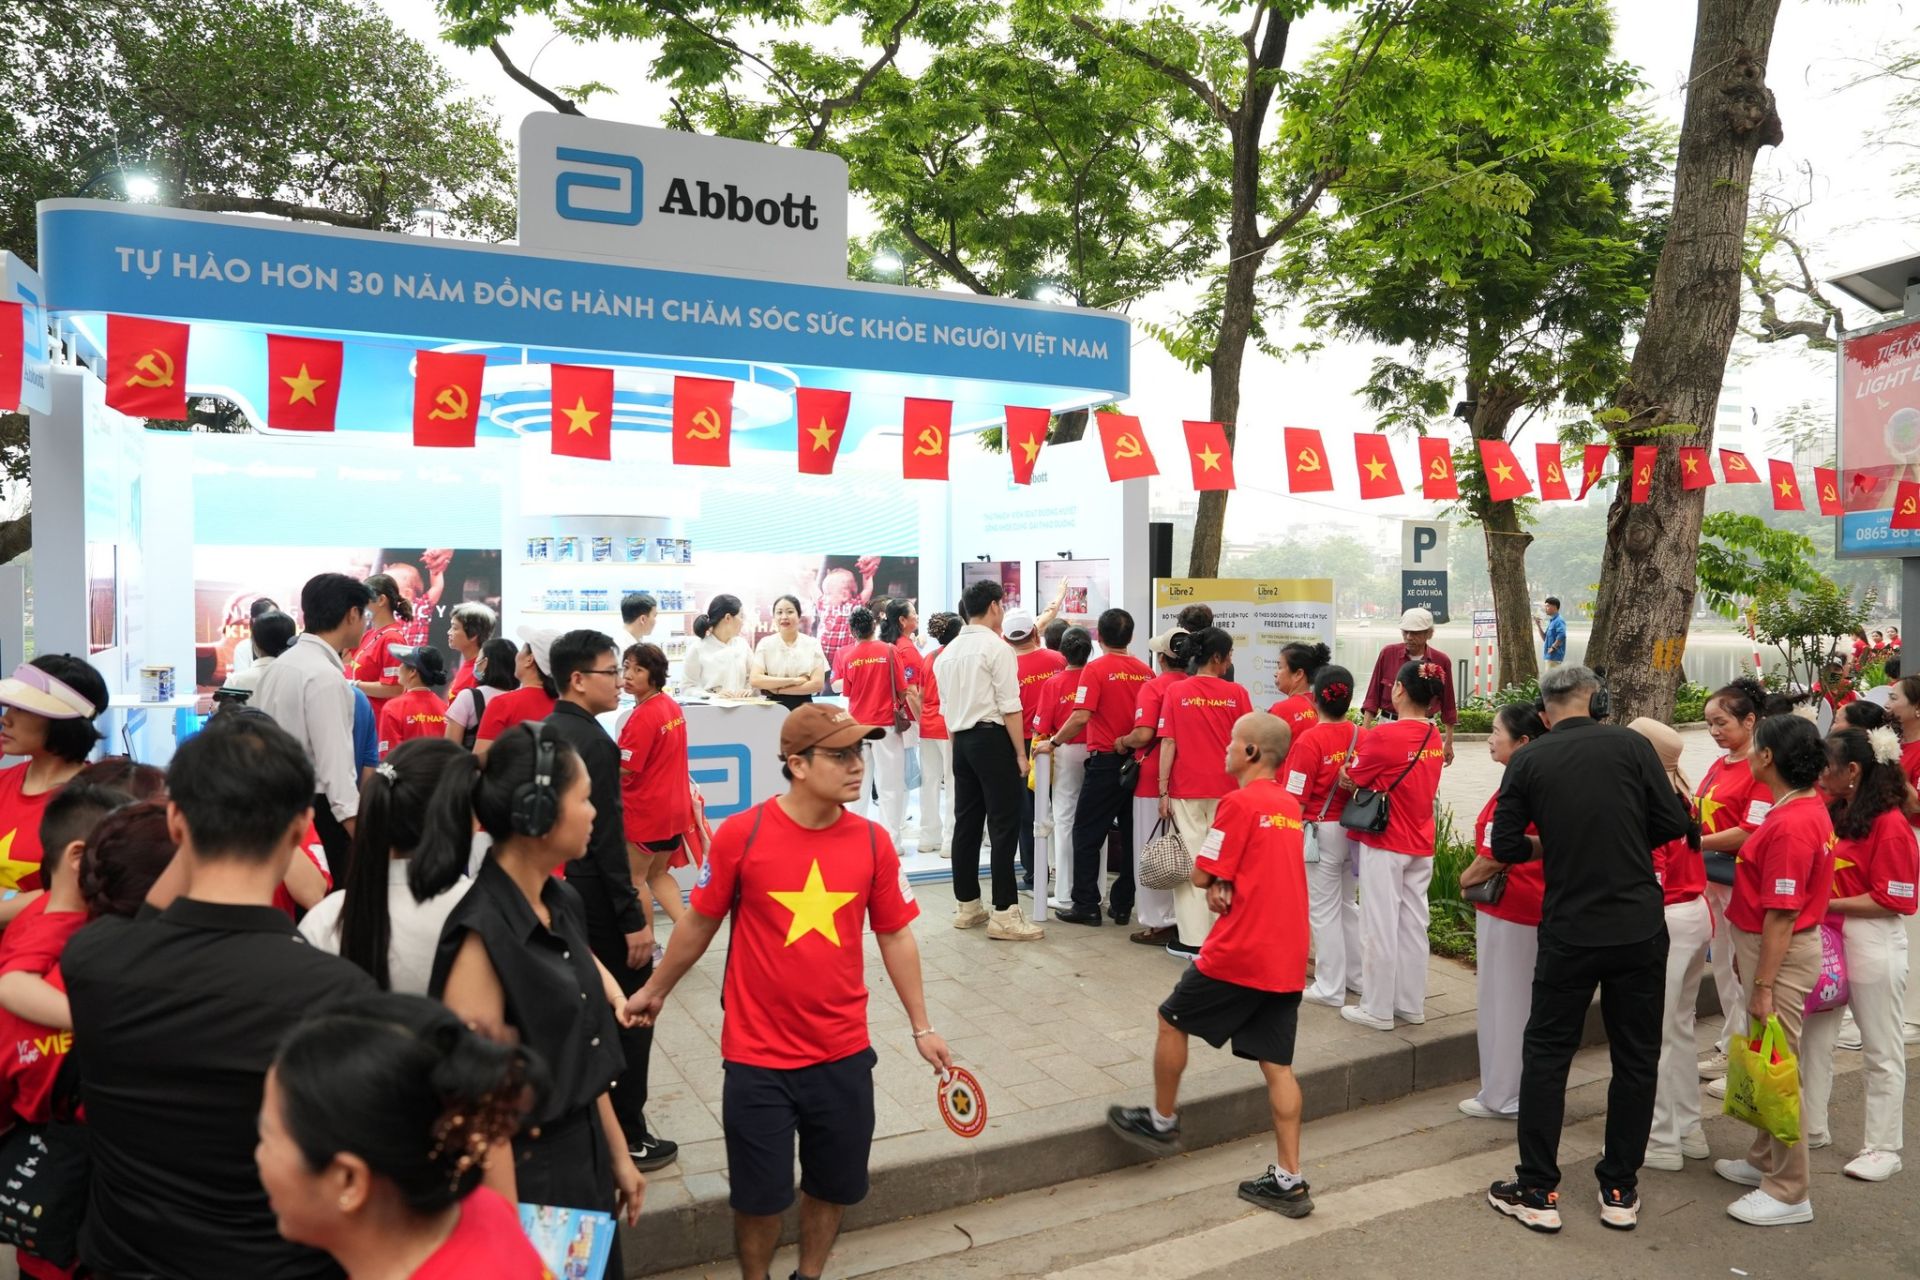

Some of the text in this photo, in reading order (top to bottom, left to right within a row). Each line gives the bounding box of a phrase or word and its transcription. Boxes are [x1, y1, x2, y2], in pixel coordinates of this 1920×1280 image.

[659, 177, 819, 231] Abbott
[114, 246, 1109, 360] TỰ HÀO HƠN 30 NĂM ĐỒNG HÀNH CHĂM SÓC SỨC KHỎE NGƯỜI VIỆT NAM
[1856, 367, 1912, 400] LIGHT
[1856, 526, 1888, 541] 0865
[1413, 527, 1437, 563] P
[1170, 586, 1194, 596] Libre 2
[1258, 587, 1278, 596] Libre 2
[1407, 589, 1415, 597] XE
[1231, 621, 1236, 629] 2
[1187, 696, 1206, 707] VIỆT
[1207, 699, 1228, 707] NAM
